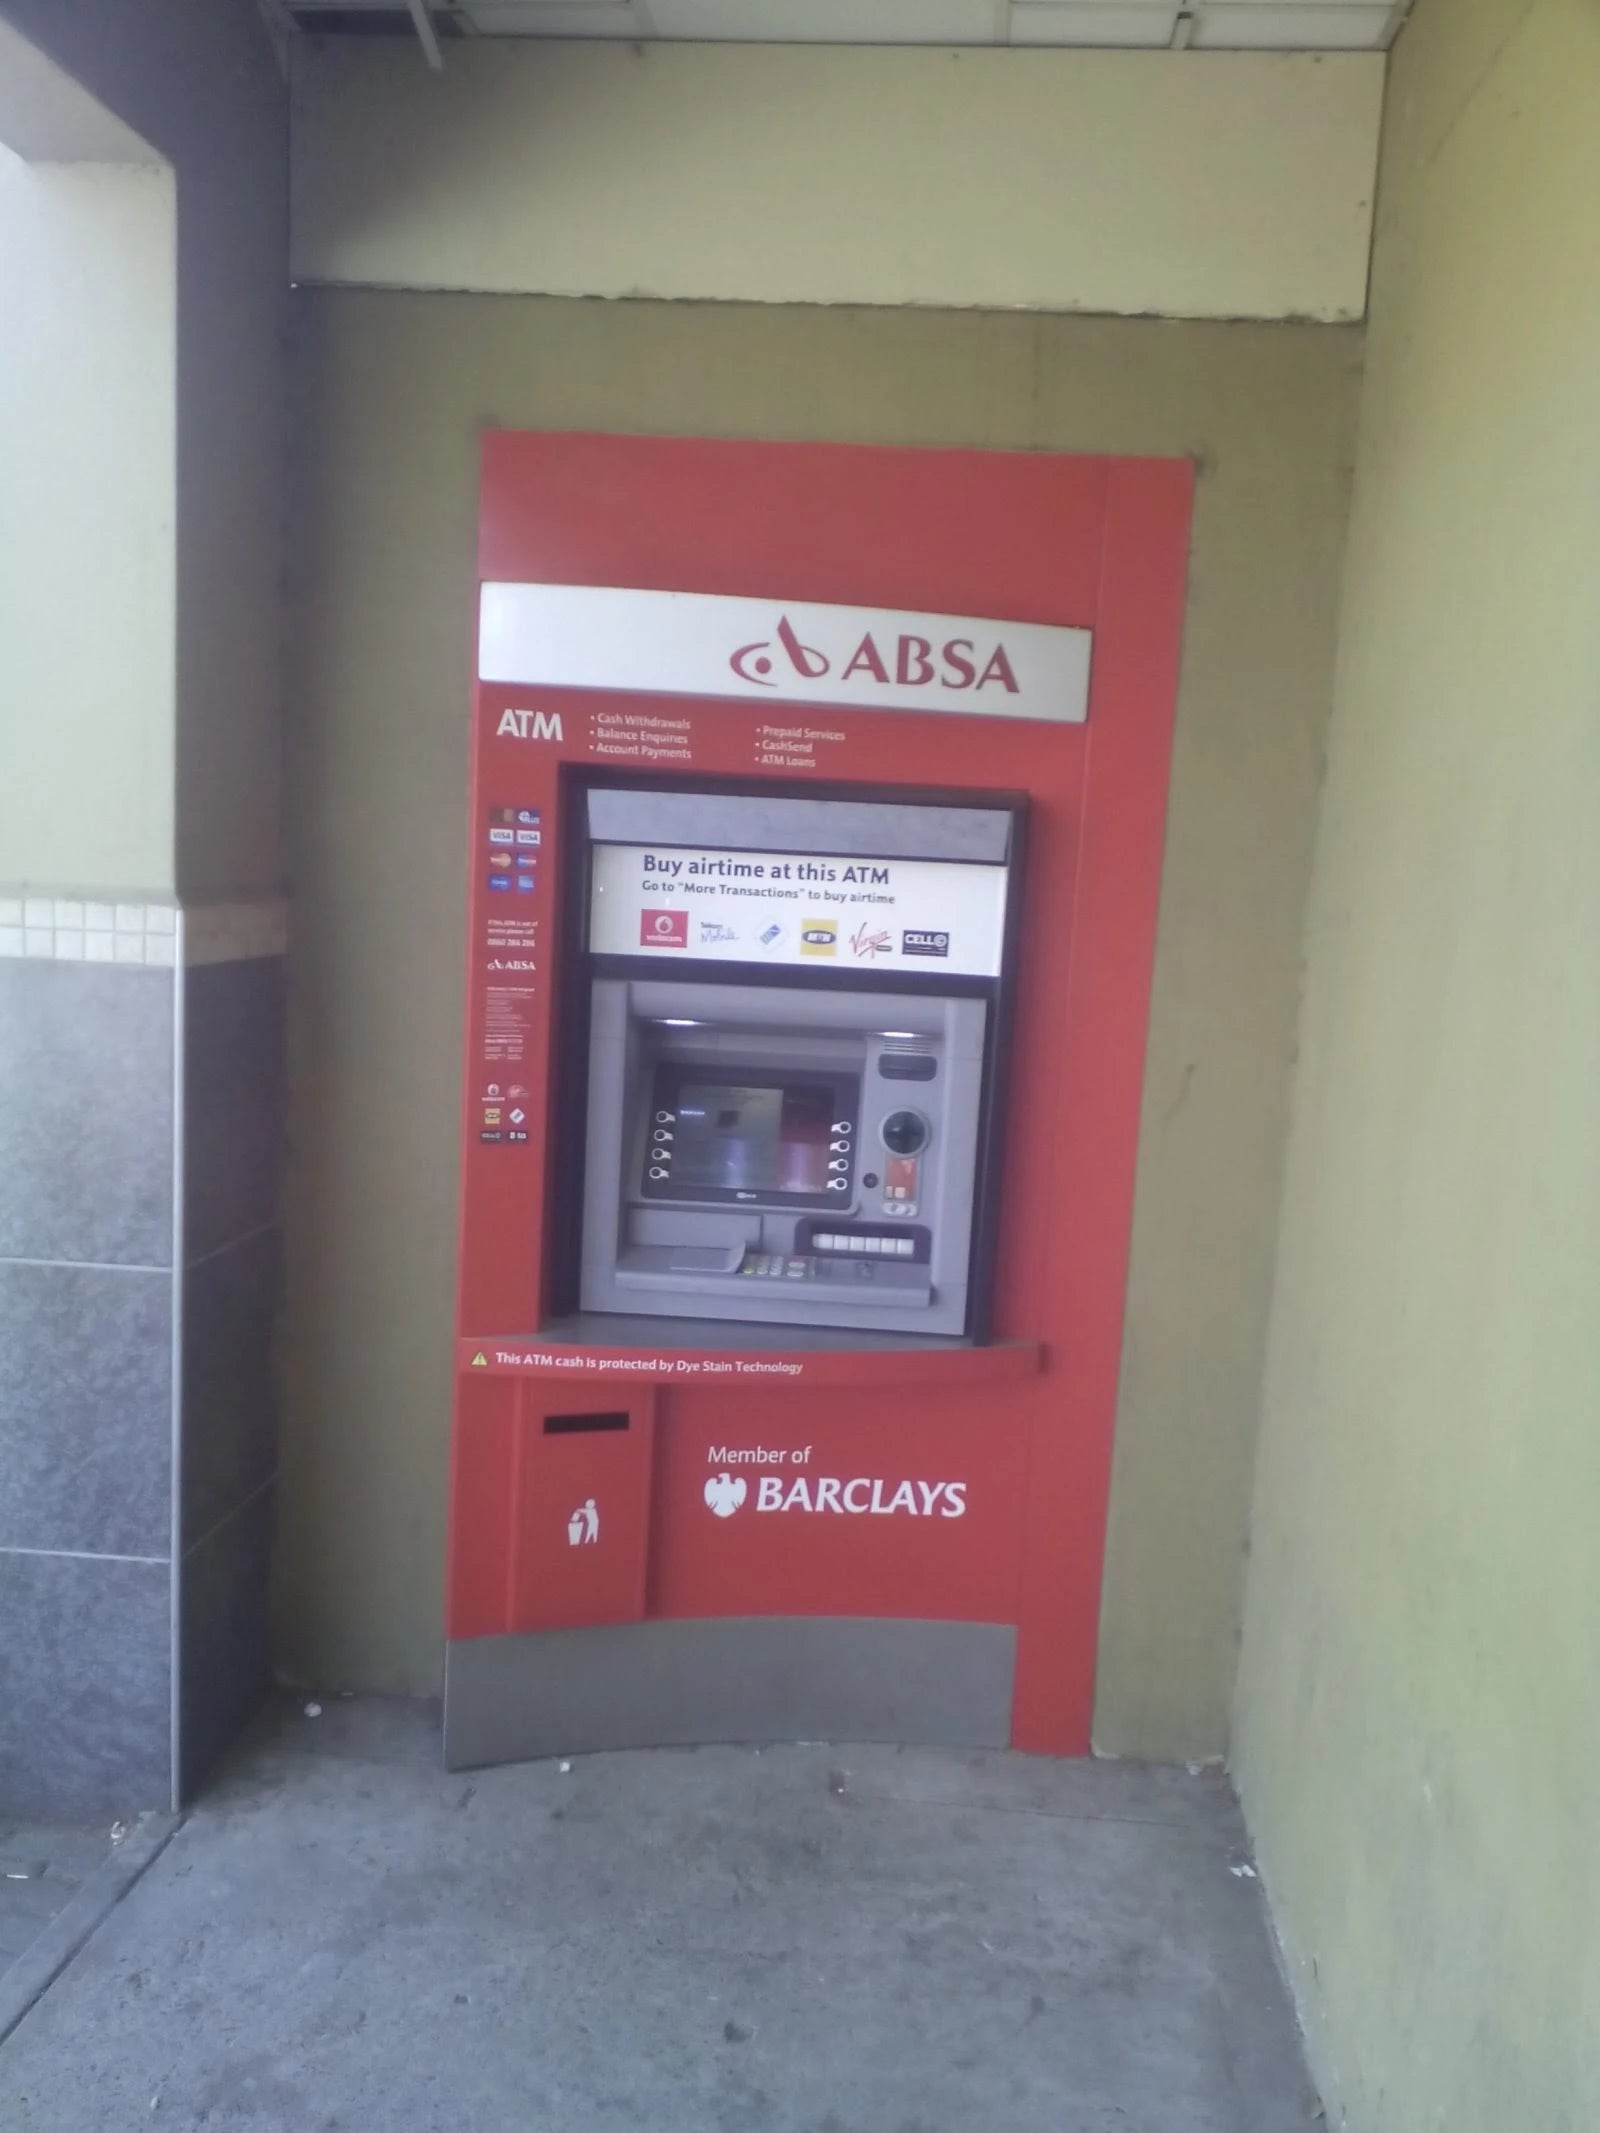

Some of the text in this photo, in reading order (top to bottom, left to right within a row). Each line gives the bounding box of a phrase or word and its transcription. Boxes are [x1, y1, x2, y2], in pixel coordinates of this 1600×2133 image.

[841, 632, 1020, 693] ABSA
[496, 708, 563, 741] ATM
[597, 712, 691, 729] Cash Withdrawals
[597, 727, 688, 744] Balance Enquiries
[763, 725, 846, 741] Prepaid Services
[596, 742, 692, 759] Account Payments
[762, 740, 813, 753] CashSend
[761, 754, 816, 767] ATM Loans
[643, 855, 889, 885] Buy airtime at this ATM
[642, 880, 659, 891] Go
[662, 882, 675, 892] to
[808, 889, 821, 900] to
[824, 889, 847, 904] buy
[850, 892, 896, 904] airtime
[505, 960, 537, 970] ABSA
[496, 1352, 803, 1375] This ATM cash is protected by Dye Stain Technology
[707, 1445, 813, 1464] Member of
[756, 1477, 967, 1518] BARCLAYS
